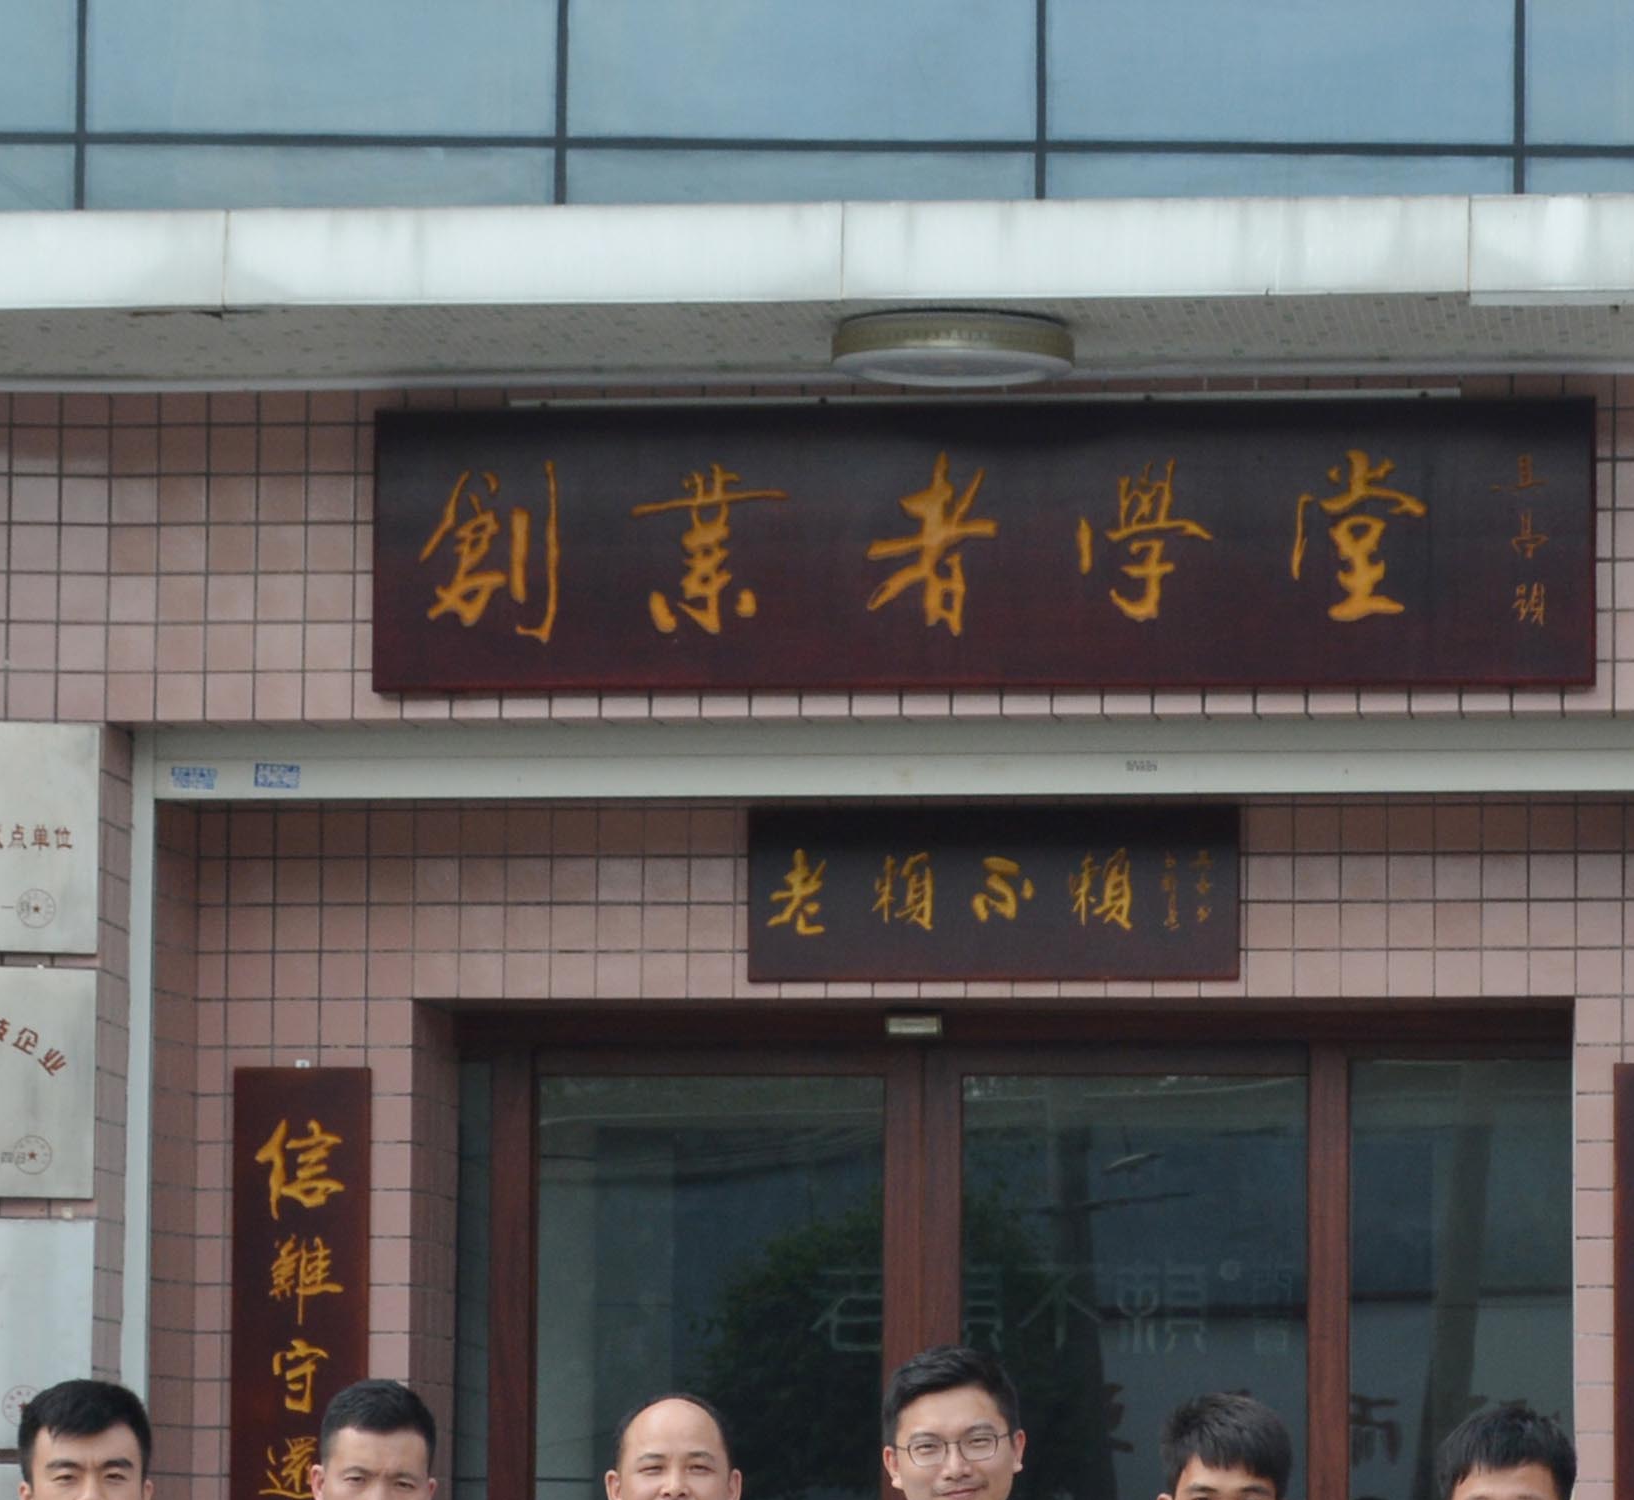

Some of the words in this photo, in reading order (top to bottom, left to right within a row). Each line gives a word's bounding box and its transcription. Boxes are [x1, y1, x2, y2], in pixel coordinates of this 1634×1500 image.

[419, 448, 1427, 644] 創業者學堂
